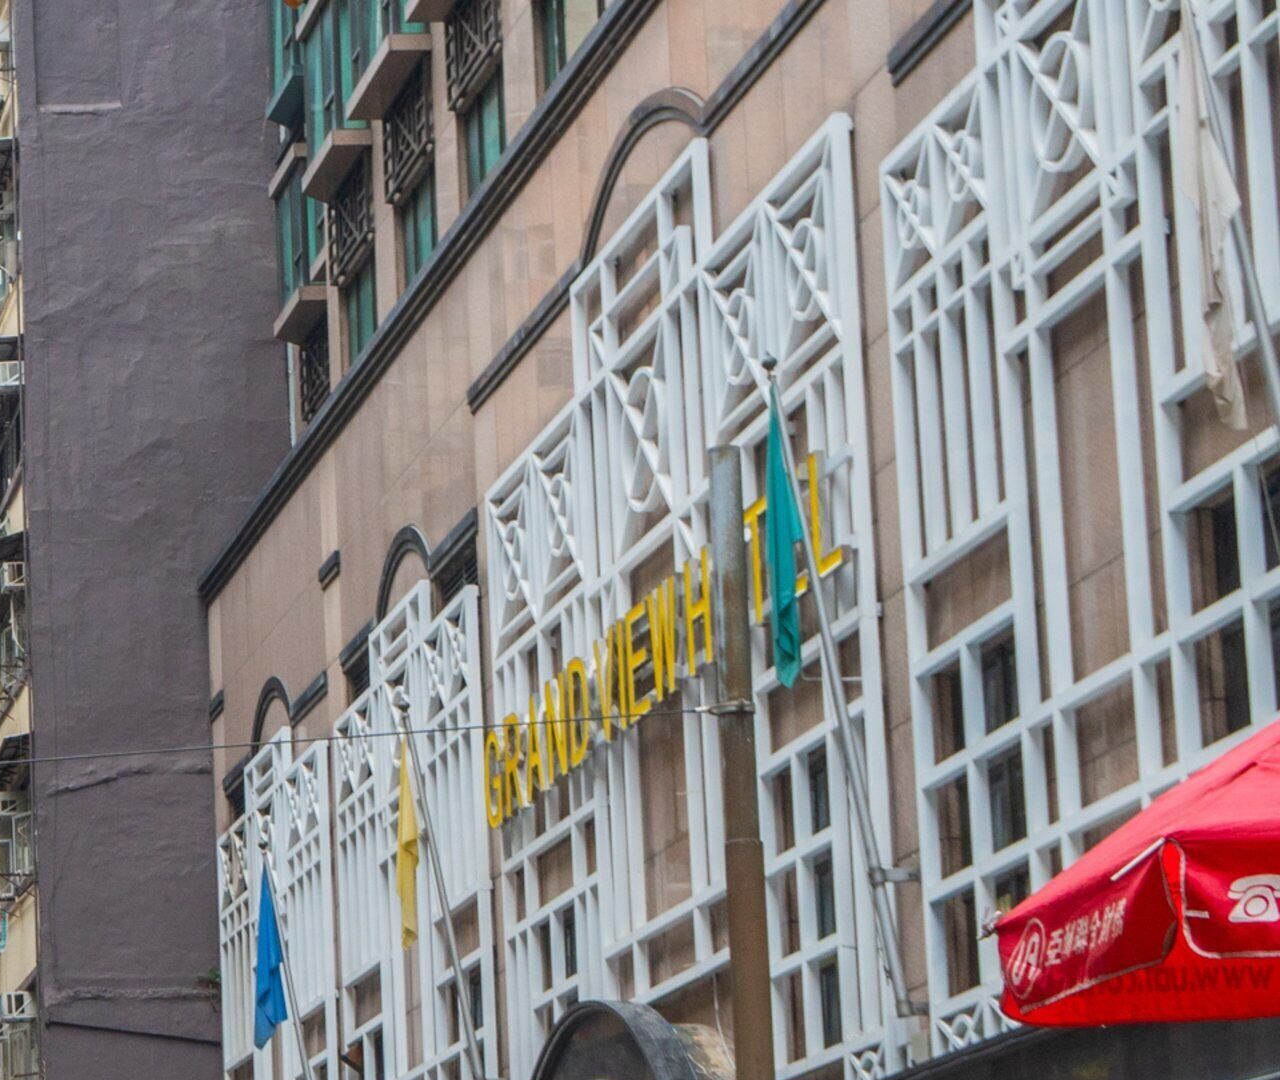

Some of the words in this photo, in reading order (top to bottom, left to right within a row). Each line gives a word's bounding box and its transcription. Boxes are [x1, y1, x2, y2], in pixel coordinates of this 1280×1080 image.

[484, 655, 591, 830] GRAND
[592, 574, 677, 743] VIEW
[682, 452, 843, 680] HTL
